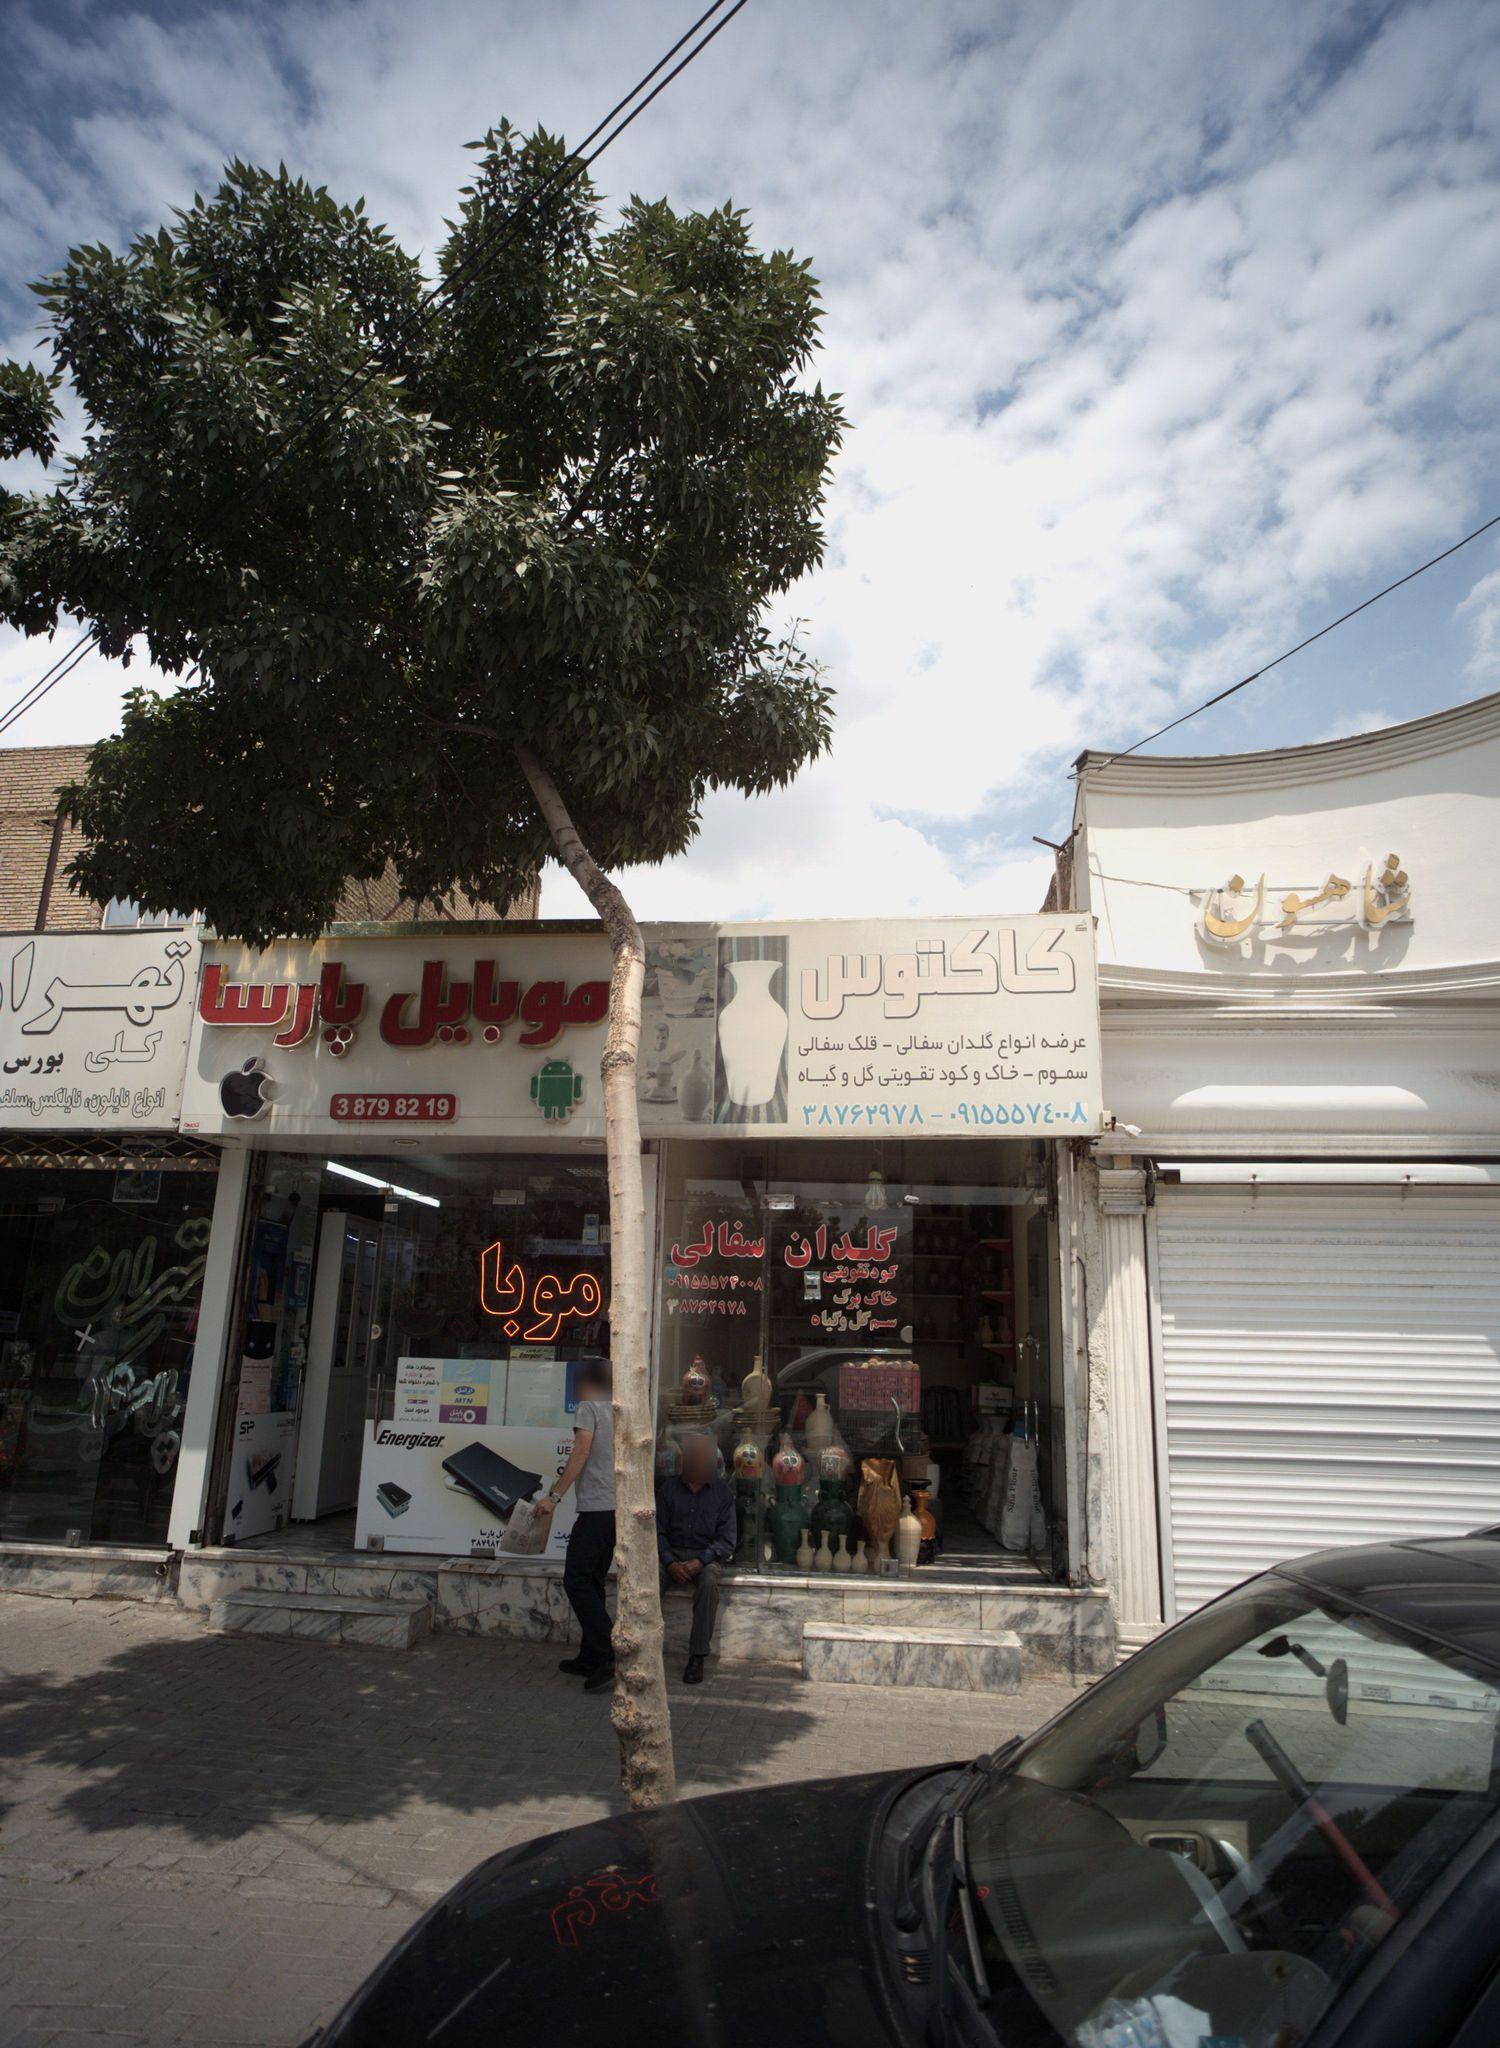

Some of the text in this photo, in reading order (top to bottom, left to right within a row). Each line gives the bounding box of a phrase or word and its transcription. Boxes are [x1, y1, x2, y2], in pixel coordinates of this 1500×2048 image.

[801, 928, 1077, 1020] کاکتوس
[0, 940, 192, 1035] تهرا
[199, 959, 611, 1058] موبایل پارسا
[798, 1036, 843, 1057] سفالی
[848, 1034, 878, 1052] قلک
[896, 1034, 944, 1056] سفالی
[947, 1033, 993, 1055] گلدان
[997, 1035, 1037, 1059] انواع
[1040, 1035, 1087, 1053] عرضه
[3, 1050, 64, 1074] بورس
[798, 1064, 837, 1087] گیاه
[841, 1072, 849, 1086] و
[853, 1064, 874, 1087] گل
[878, 1065, 935, 1087] تقویتی
[938, 1065, 968, 1083] کود
[973, 1072, 981, 1085] و
[985, 1065, 1019, 1084] خاک
[1038, 1066, 1088, 1086] سموم
[131, 1087, 166, 1118] انواع
[336, 1099, 450, 1117] 3 879 82 19
[671, 1220, 898, 1268] گلدان سفالی
[864, 1289, 898, 1306] خاک
[848, 1309, 872, 1331] گل
[869, 1318, 898, 1331] سم
[376, 1430, 444, 1450] Energizer
